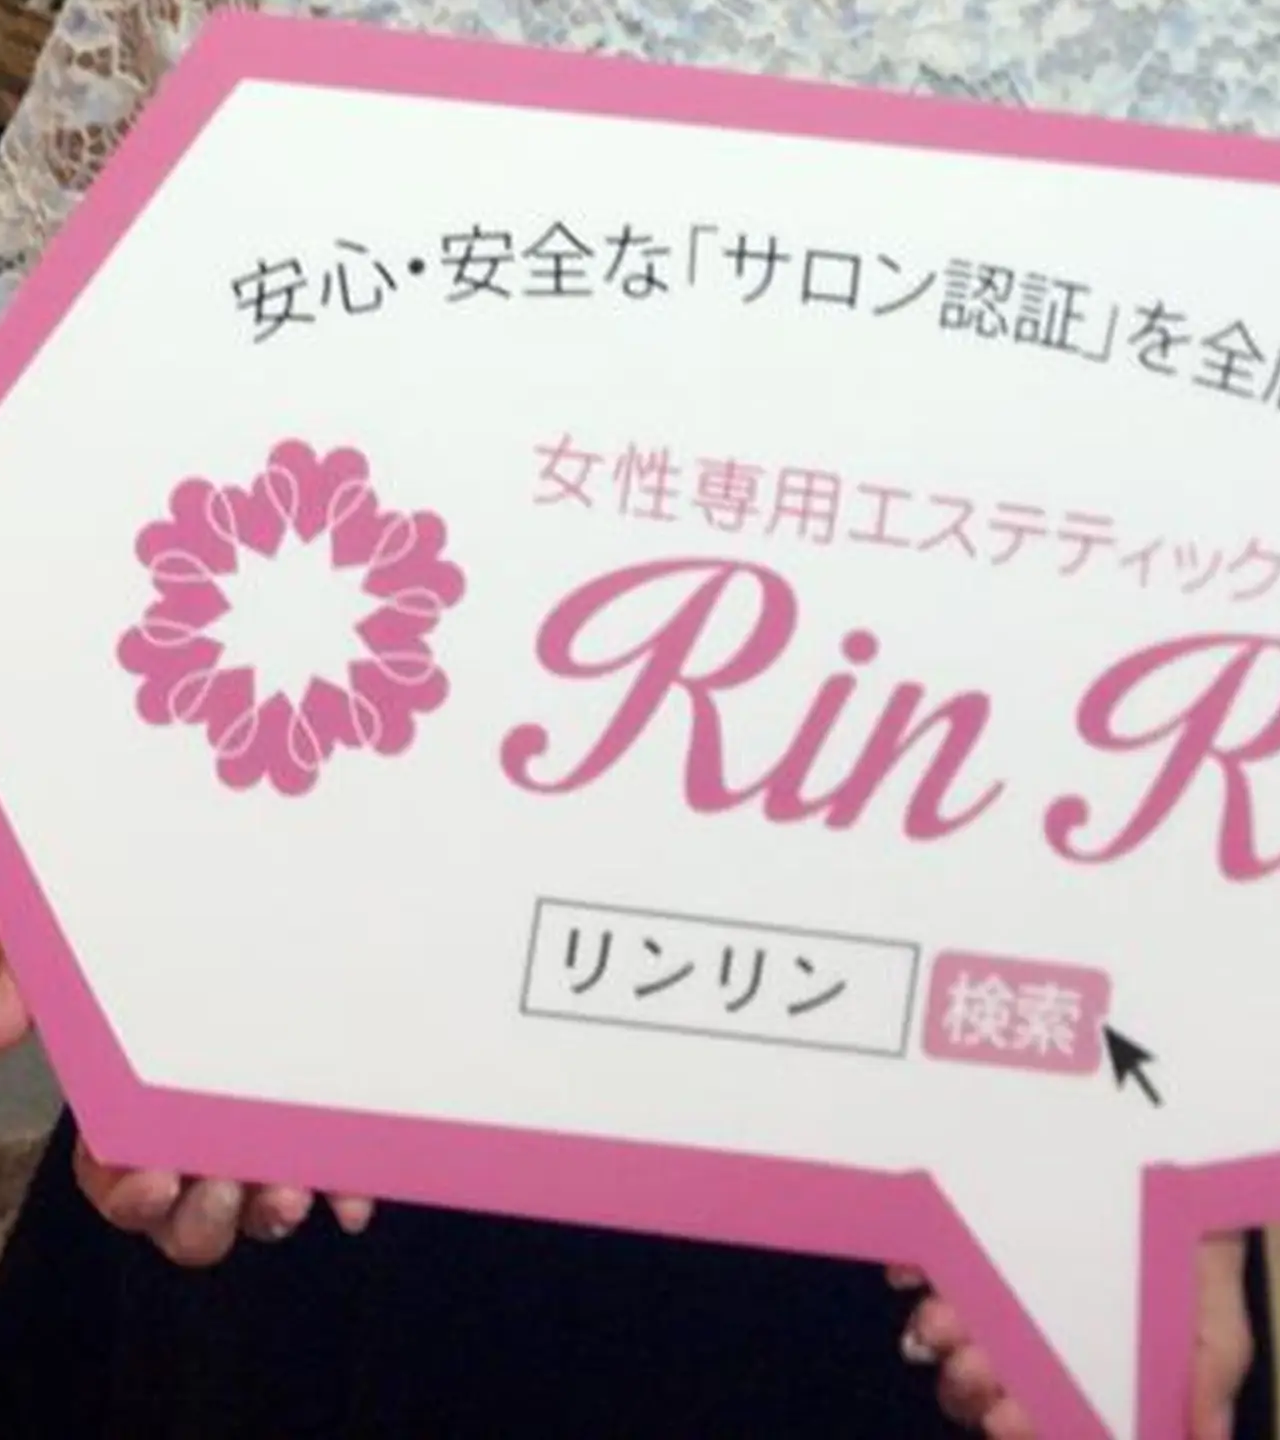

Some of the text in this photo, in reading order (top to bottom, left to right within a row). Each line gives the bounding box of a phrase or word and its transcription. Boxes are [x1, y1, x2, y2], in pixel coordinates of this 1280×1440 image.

[500, 555, 1007, 841] Rin
[565, 928, 846, 1015] リンリン
[941, 972, 1084, 1056] 検索
